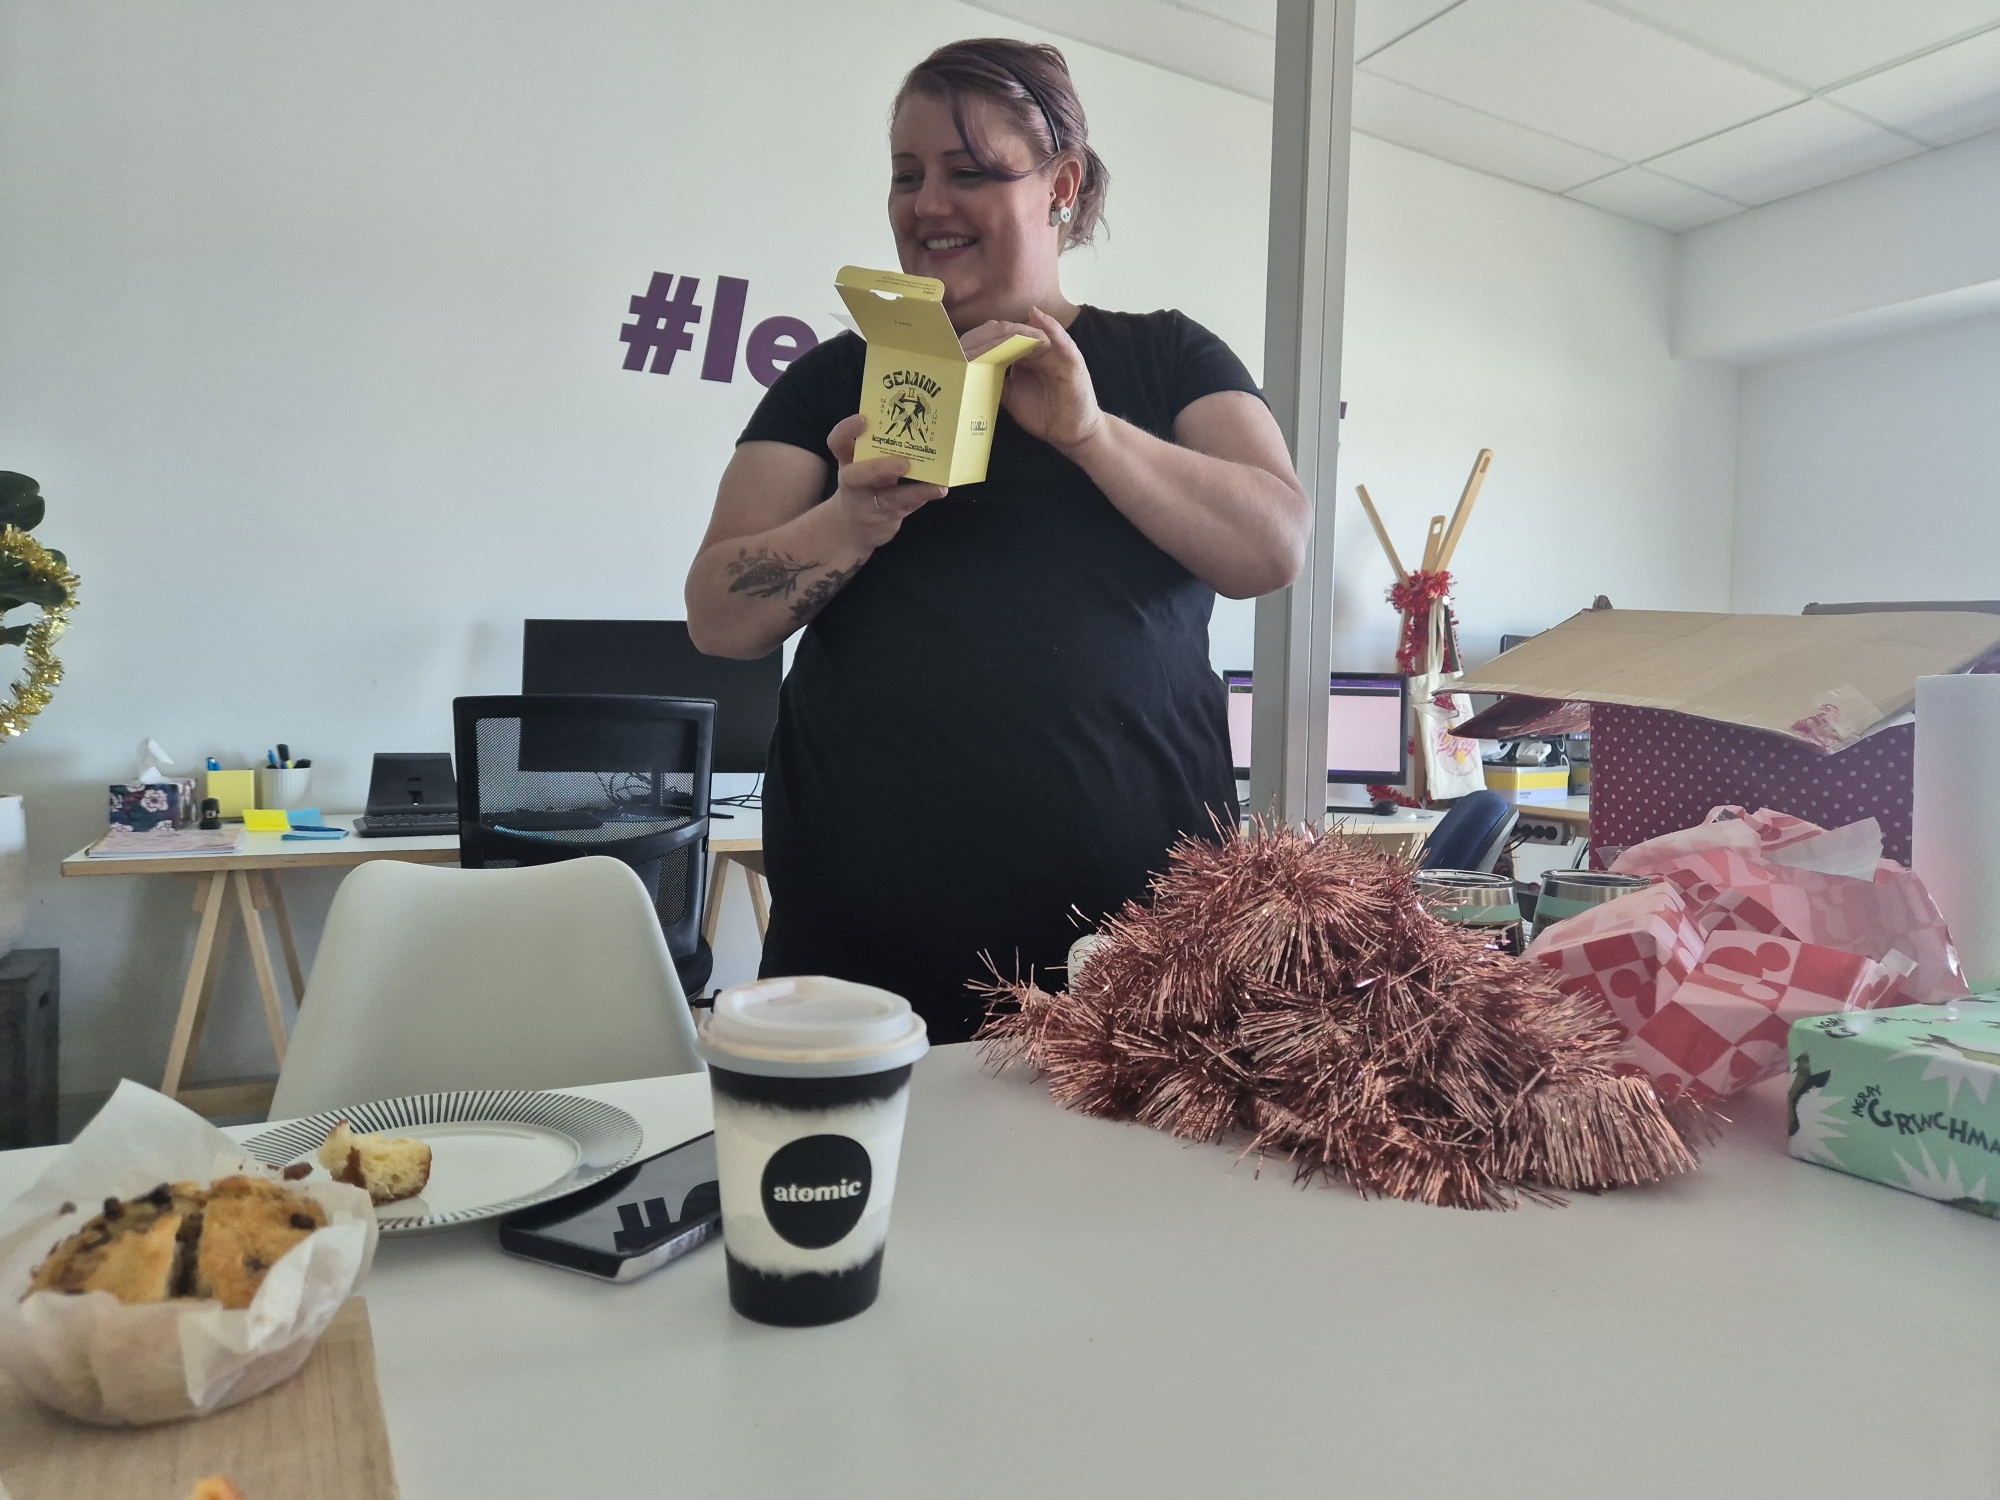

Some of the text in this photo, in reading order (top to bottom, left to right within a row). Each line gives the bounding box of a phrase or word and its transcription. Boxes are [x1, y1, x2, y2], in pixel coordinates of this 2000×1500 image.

[882, 370, 942, 398] GEMINI
[1851, 1084, 1882, 1118] MERRY
[773, 1178, 862, 1202] atomic
